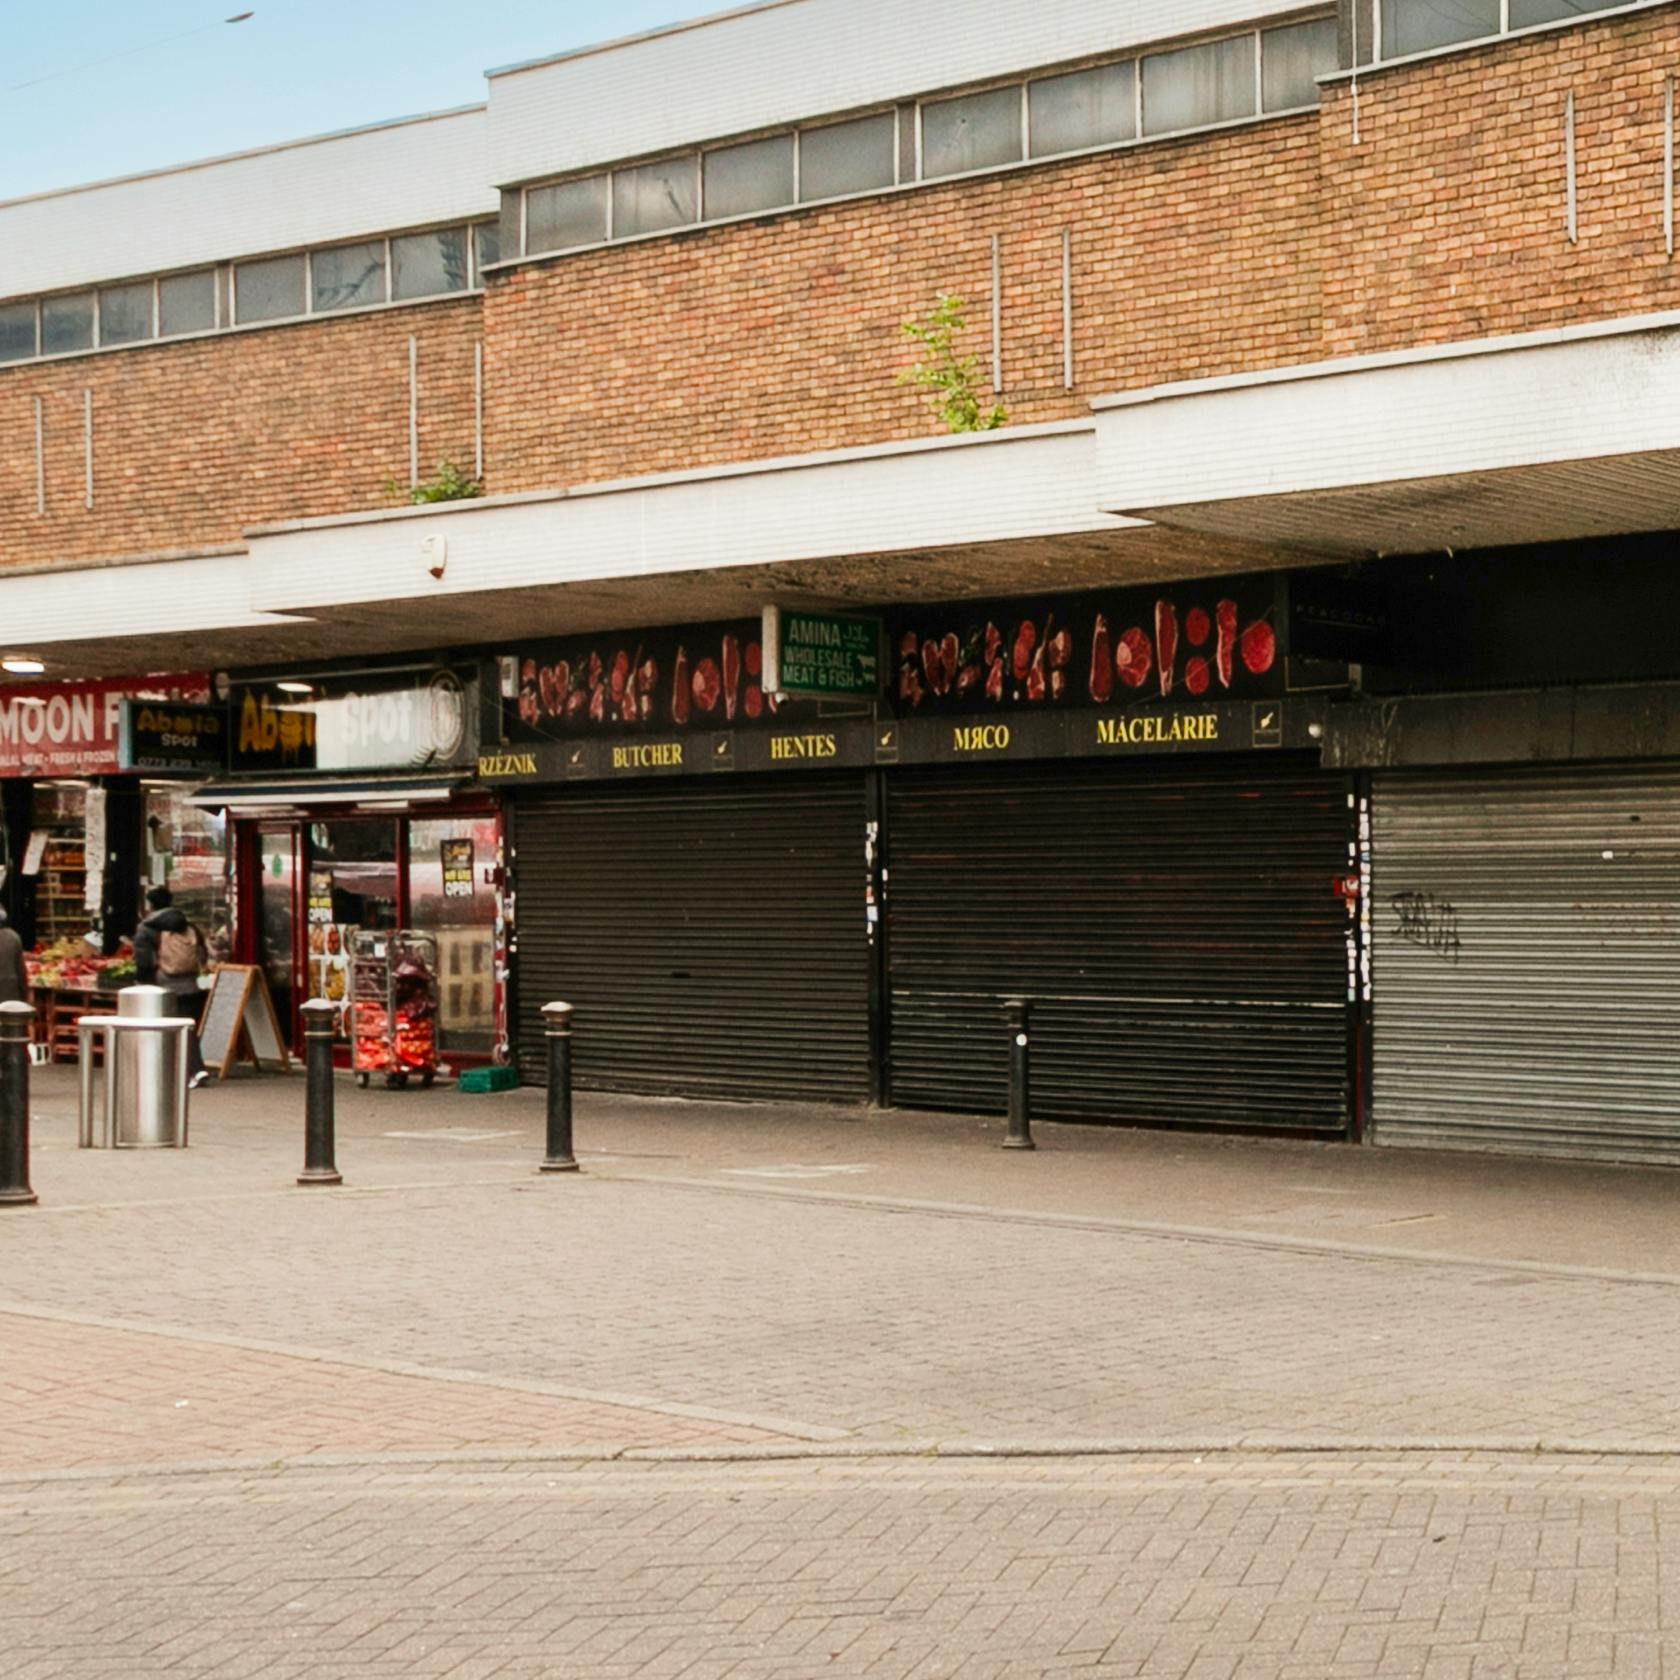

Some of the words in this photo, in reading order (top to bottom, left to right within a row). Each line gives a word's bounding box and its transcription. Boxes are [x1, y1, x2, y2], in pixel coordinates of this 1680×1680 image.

[789, 619, 841, 647] AMINA
[784, 645, 853, 669] WHOLESALE
[783, 664, 815, 684] MEAT
[829, 668, 855, 687] FISH
[0, 695, 94, 745] MOON
[612, 743, 683, 768] BUTCHER
[770, 734, 837, 759] HENTES
[444, 881, 473, 897] OPEN
